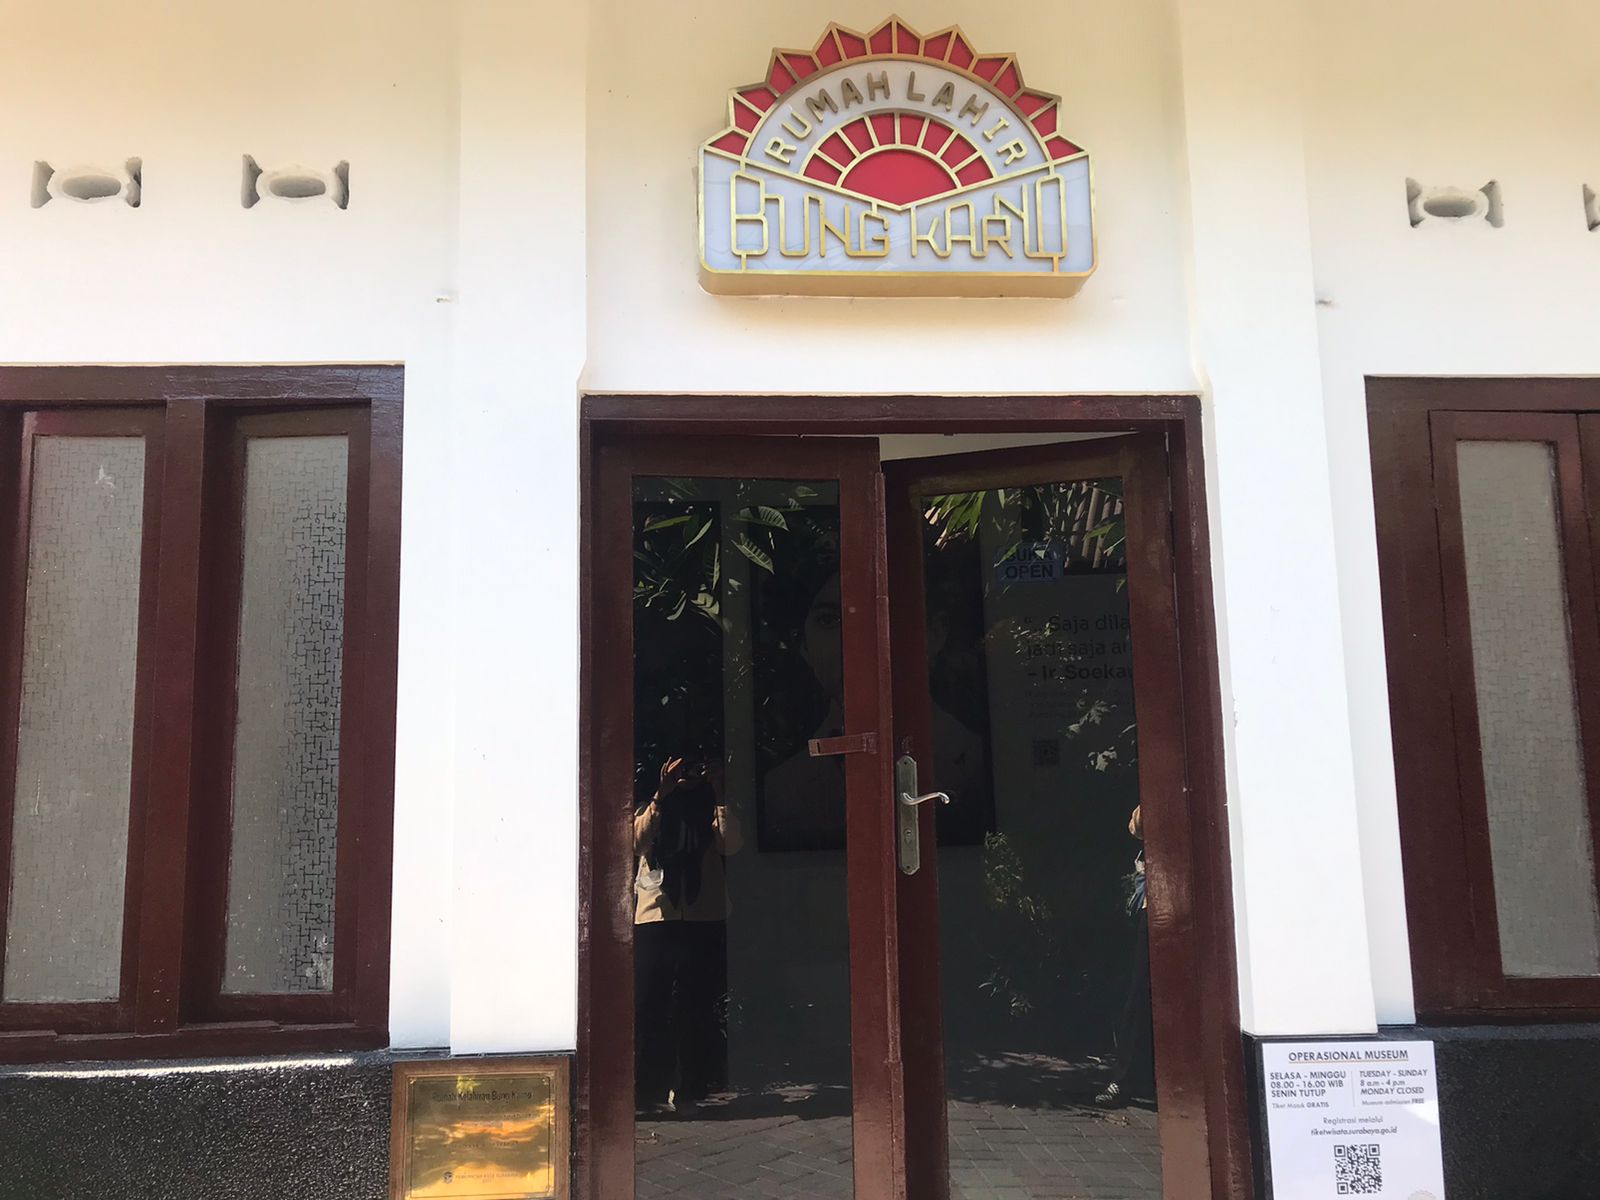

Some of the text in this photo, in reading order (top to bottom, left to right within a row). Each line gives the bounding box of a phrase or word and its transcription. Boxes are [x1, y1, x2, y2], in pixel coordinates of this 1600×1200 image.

[763, 70, 1028, 167] RUMAH LAHIR
[730, 170, 1067, 260] BUNG KARNO
[1005, 564, 1054, 579] OPEN
[1288, 1050, 1409, 1062] OPERASIONAL MUSEUM
[1270, 1071, 1302, 1080] SELASA
[1309, 1071, 1346, 1079] MINGGU
[1360, 1070, 1392, 1078] TUESDAY
[1398, 1069, 1428, 1077] SUNDAY
[1270, 1081, 1294, 1089] 08.00
[1303, 1080, 1326, 1088] 16.00
[1328, 1079, 1344, 1087] WIB
[1271, 1089, 1326, 1098] SENIN TUTUP
[1323, 1117, 1356, 1125] Registrasi
[1311, 1126, 1398, 1136] tiketwisata.surabaya.go.id
